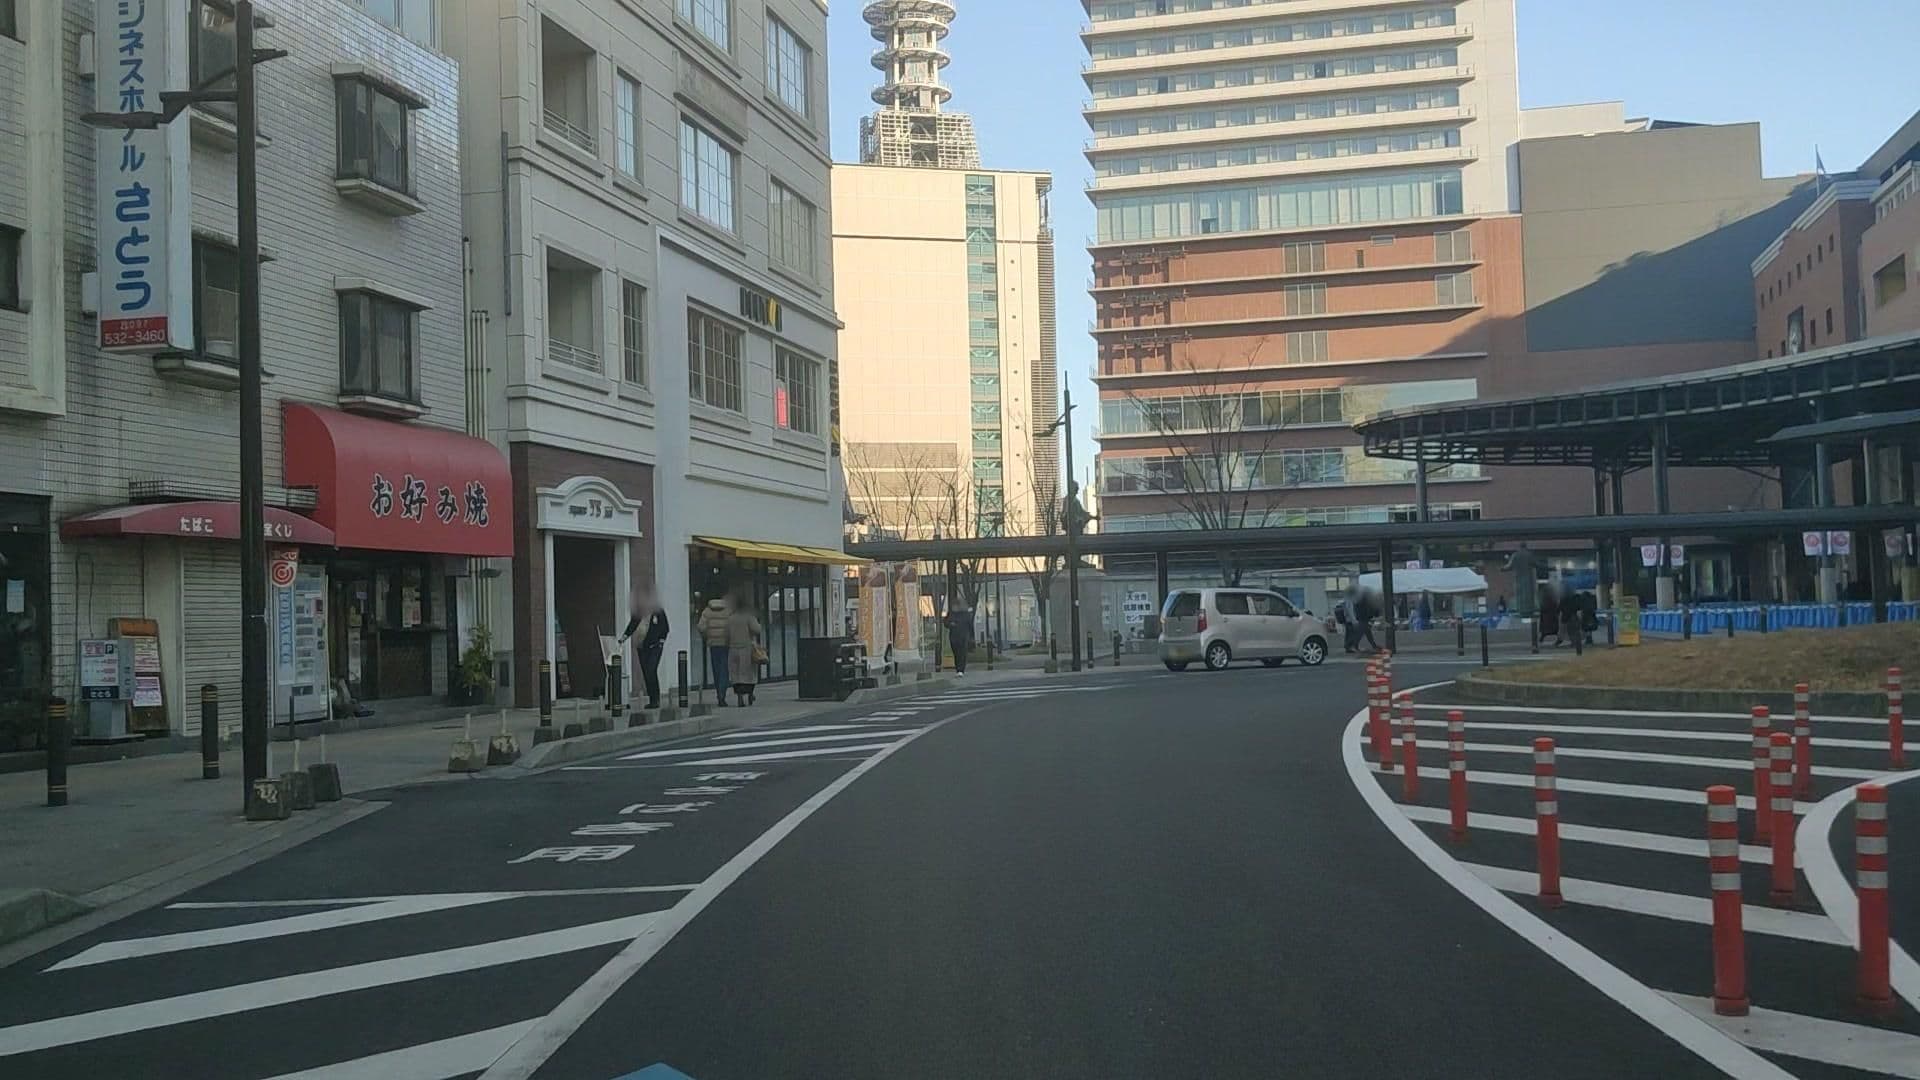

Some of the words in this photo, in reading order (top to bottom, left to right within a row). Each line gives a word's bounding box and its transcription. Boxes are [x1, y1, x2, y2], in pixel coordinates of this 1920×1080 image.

[115, 182, 151, 311] さとう
[370, 472, 489, 528] お好み焼
[180, 516, 214, 533] たばこ
[263, 523, 292, 538] 宝くじ
